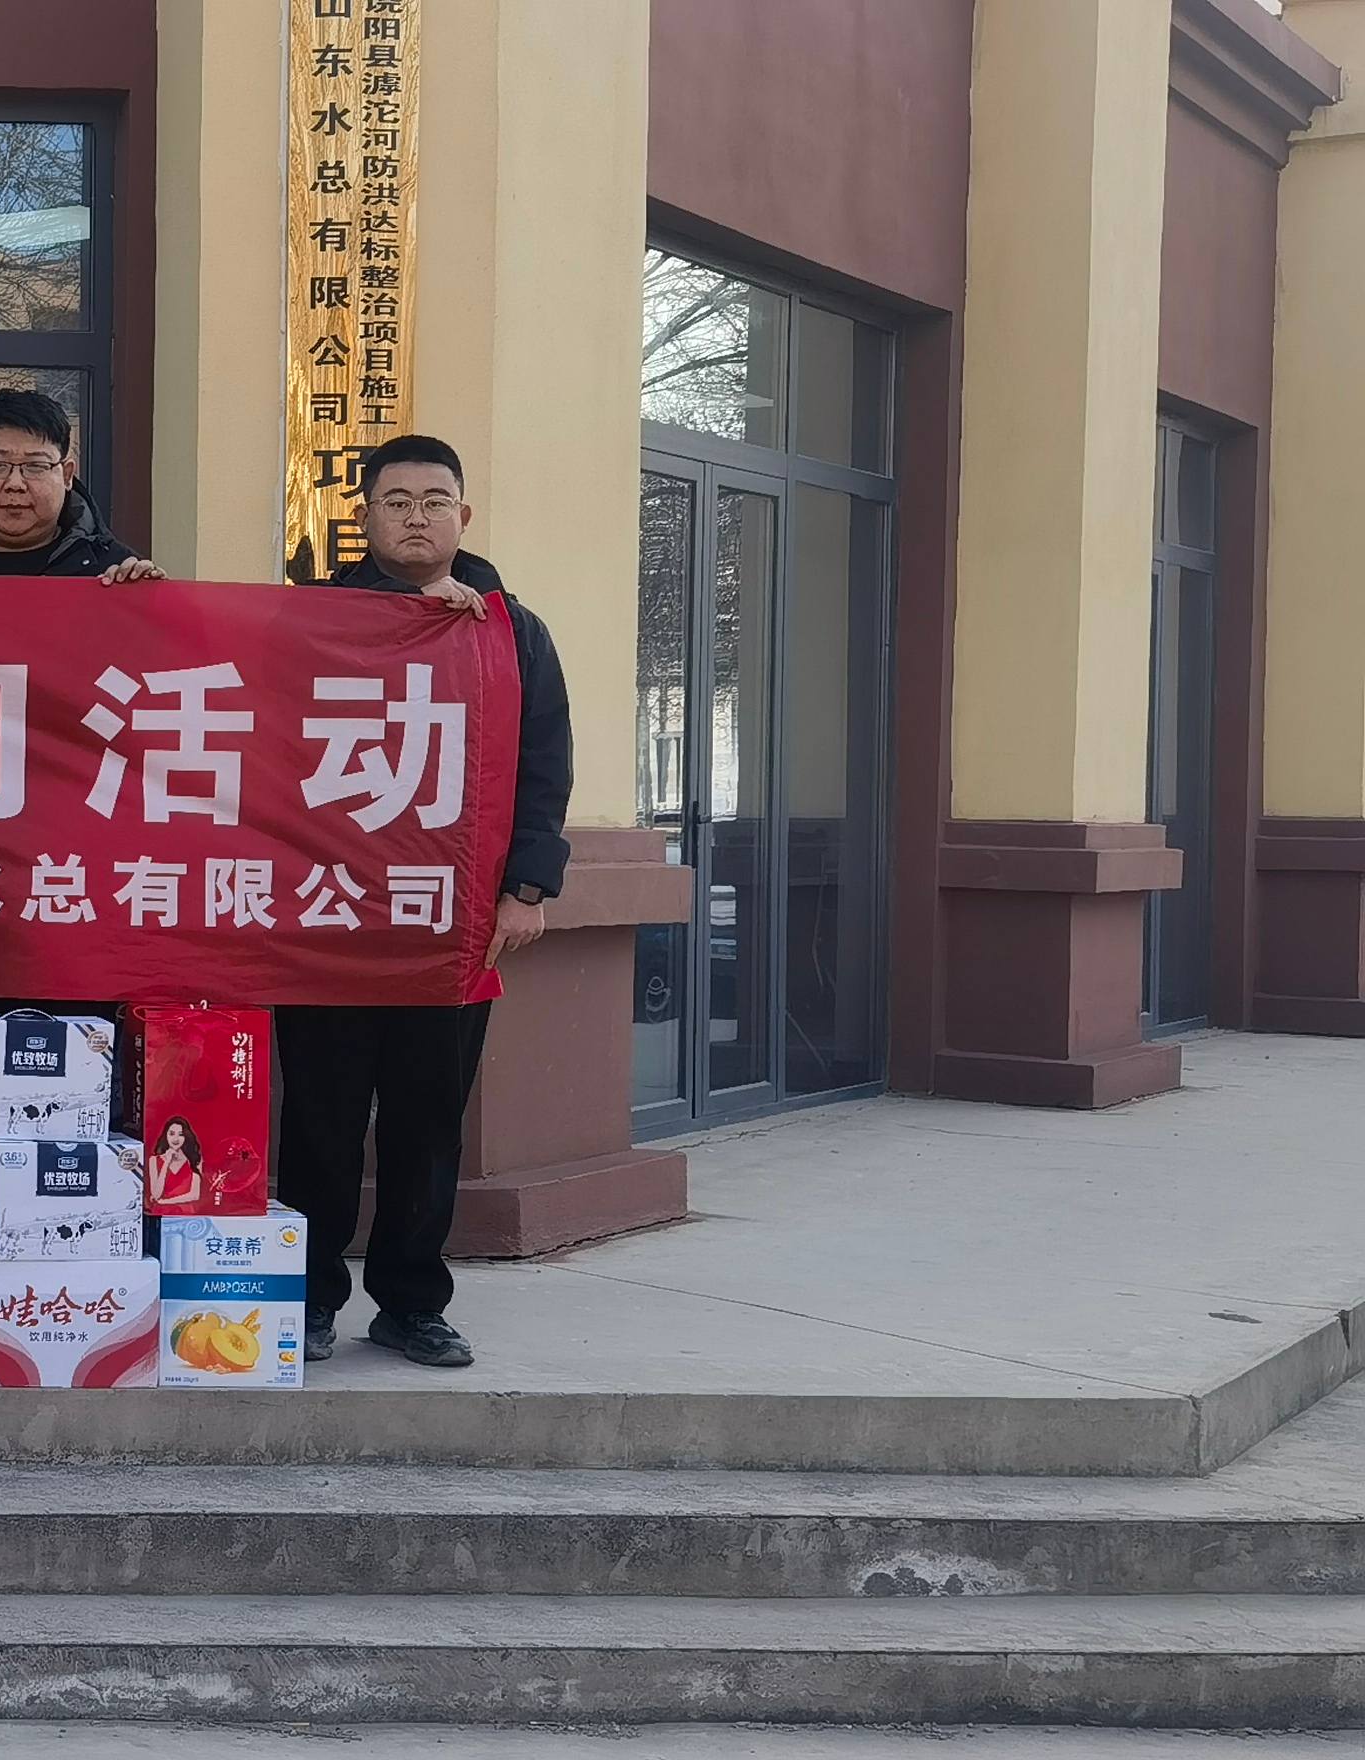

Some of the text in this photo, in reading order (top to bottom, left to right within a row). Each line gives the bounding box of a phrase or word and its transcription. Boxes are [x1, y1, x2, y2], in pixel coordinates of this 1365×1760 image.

[11, 1050, 58, 1067] 优致牧场
[231, 1031, 249, 1100] 山楂树下
[77, 1107, 106, 1134] 纯牛奶
[43, 1171, 91, 1187] 优致牧场
[110, 1226, 138, 1253] 纯牛奶
[205, 1236, 262, 1257] 安慕希
[28, 1331, 89, 1342] 饮用纯净水
